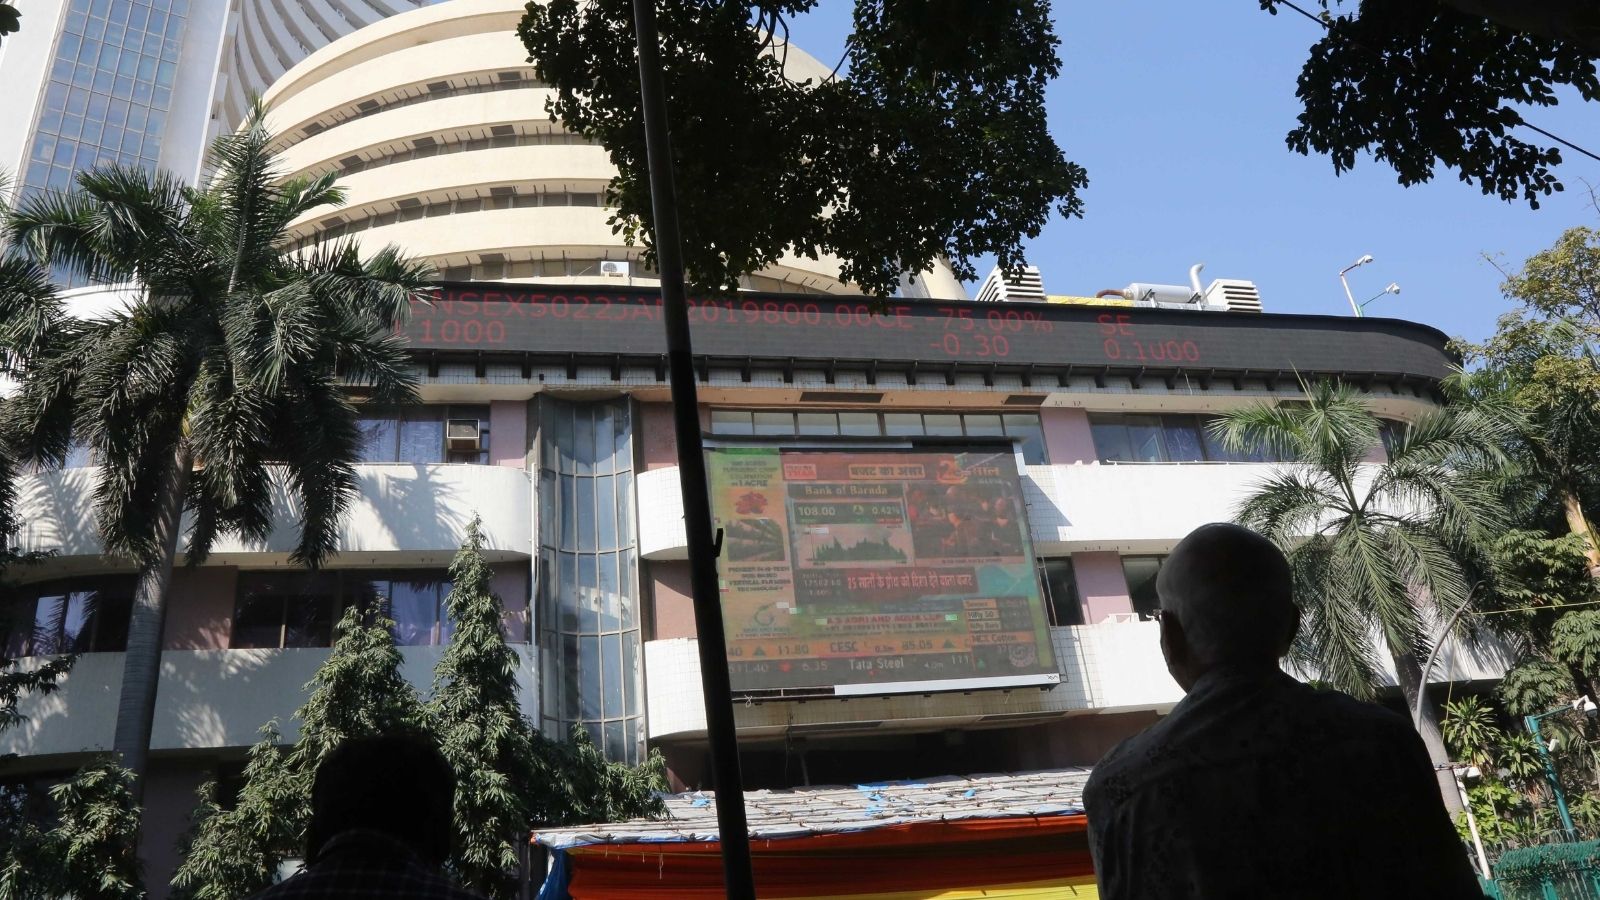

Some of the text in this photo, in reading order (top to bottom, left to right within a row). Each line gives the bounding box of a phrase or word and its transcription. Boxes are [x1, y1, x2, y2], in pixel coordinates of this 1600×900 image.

[421, 319, 506, 343] 1000
[930, 333, 1010, 357] -0.30
[805, 485, 832, 495] Bank
[836, 485, 846, 494] of
[798, 506, 836, 516] 108.00
[830, 641, 858, 653] CESC
[849, 659, 873, 671] Tata
[876, 657, 904, 669] Steel
